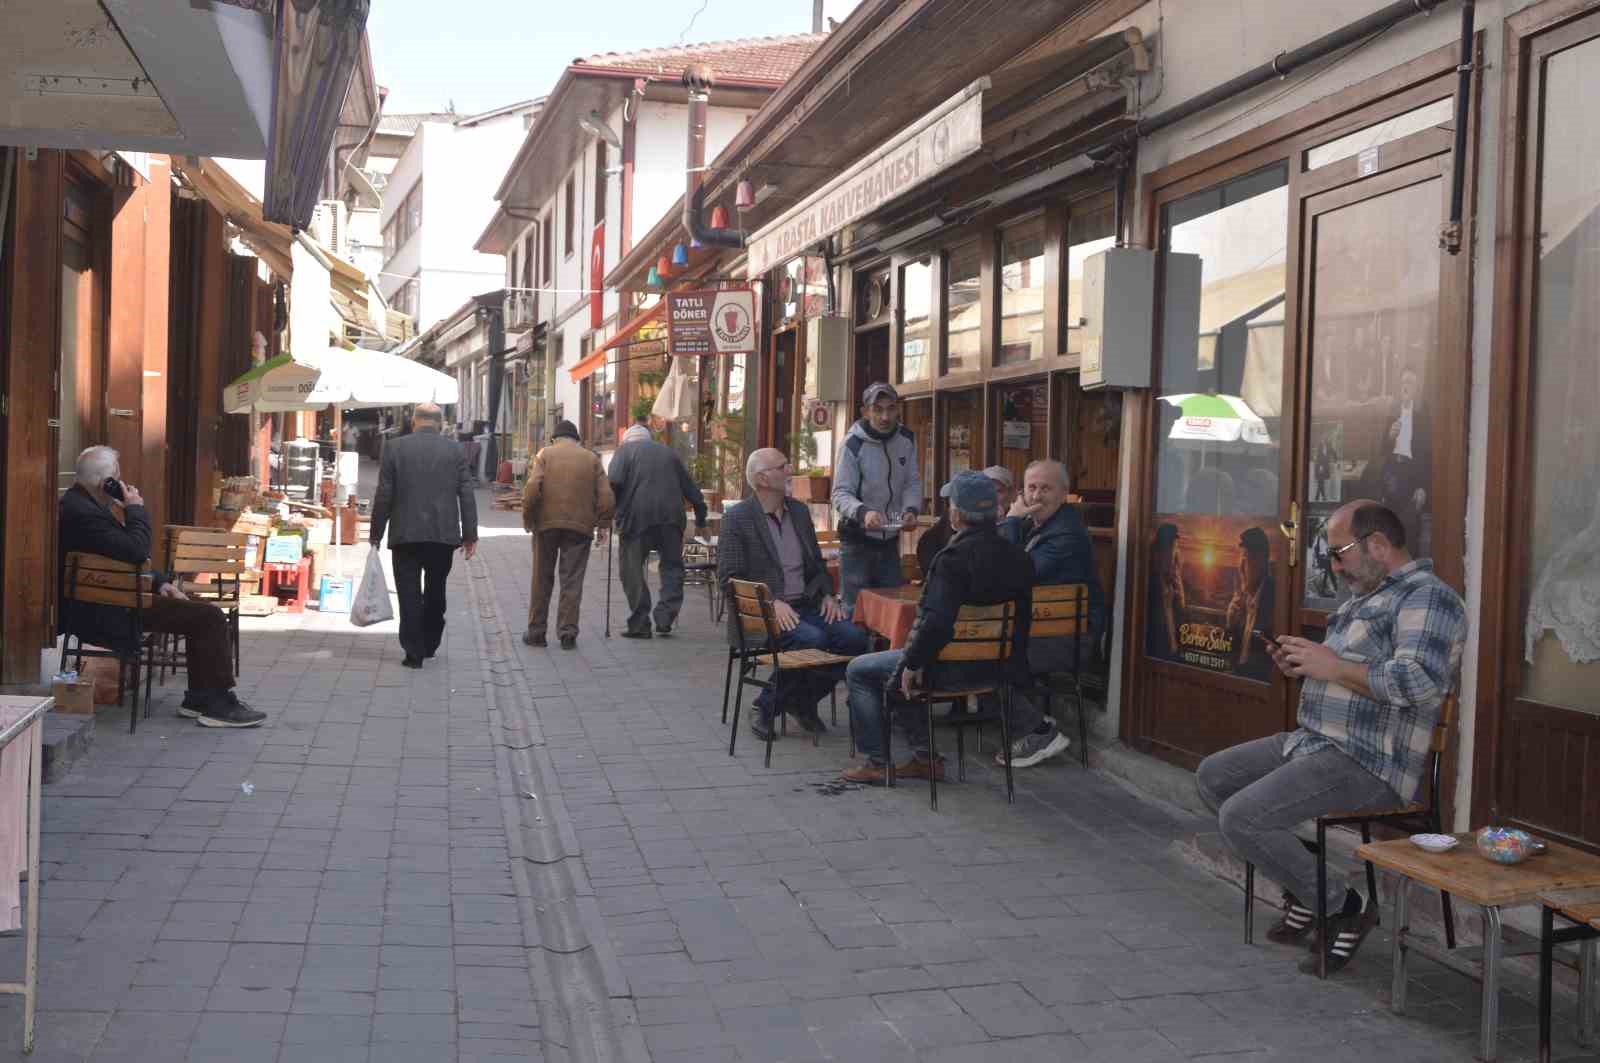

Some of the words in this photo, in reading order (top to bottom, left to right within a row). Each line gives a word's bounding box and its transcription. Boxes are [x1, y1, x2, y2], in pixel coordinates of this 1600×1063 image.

[776, 214, 817, 256] ARASTA
[821, 138, 920, 233] KAHVEHANESİ
[676, 298, 703, 307] TATLI
[673, 309, 706, 319] DÖNER
